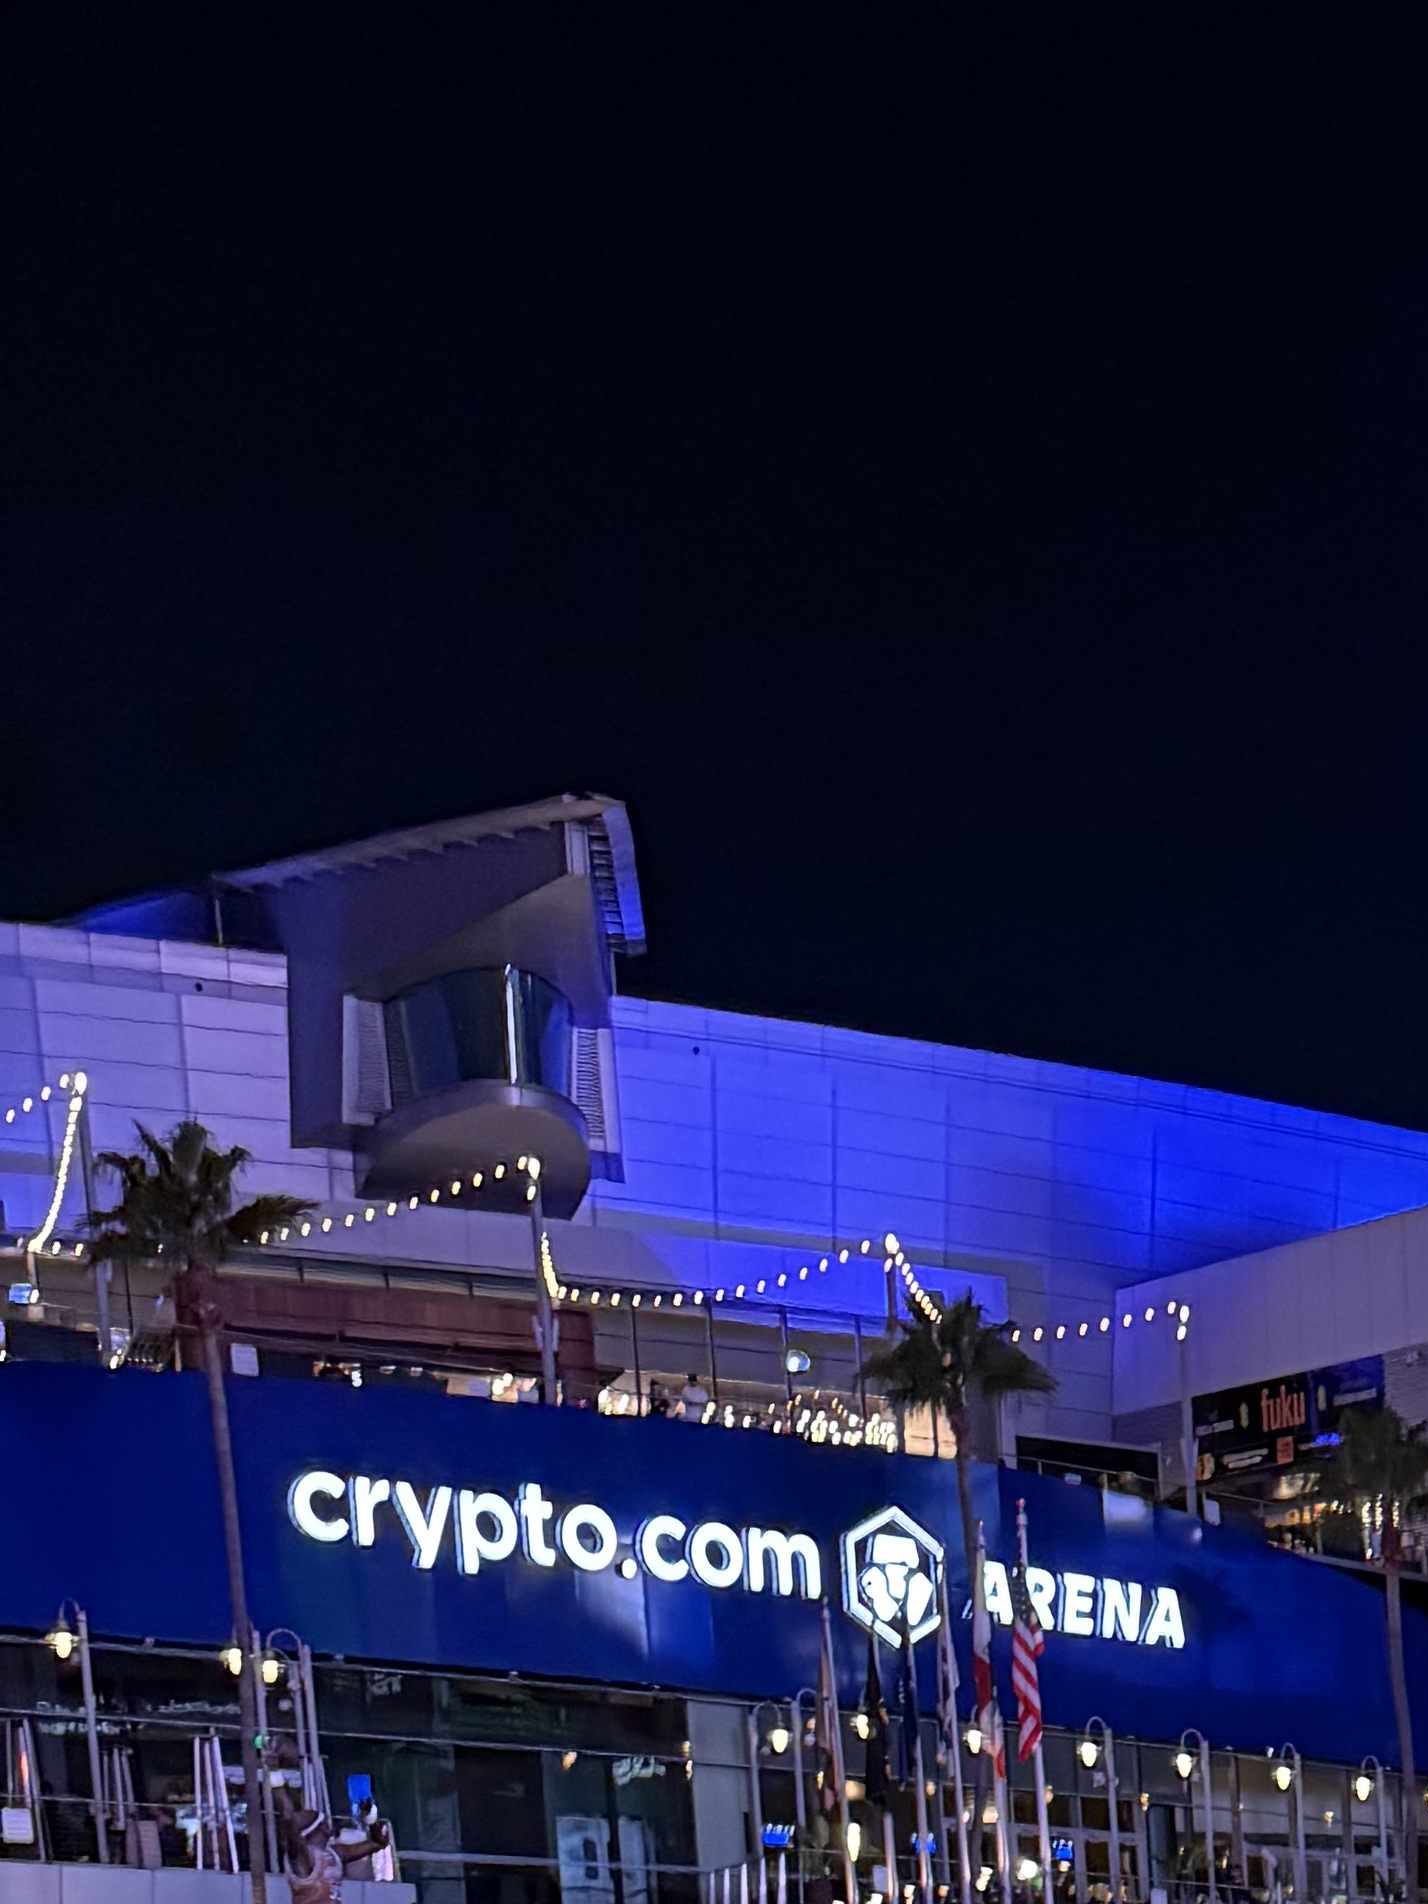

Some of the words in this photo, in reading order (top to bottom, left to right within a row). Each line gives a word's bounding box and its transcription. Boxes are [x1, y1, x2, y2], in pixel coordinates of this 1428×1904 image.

[1260, 1384, 1306, 1433] fuku
[288, 1470, 821, 1600] crypto.com
[963, 1560, 1186, 1648] ARENA
